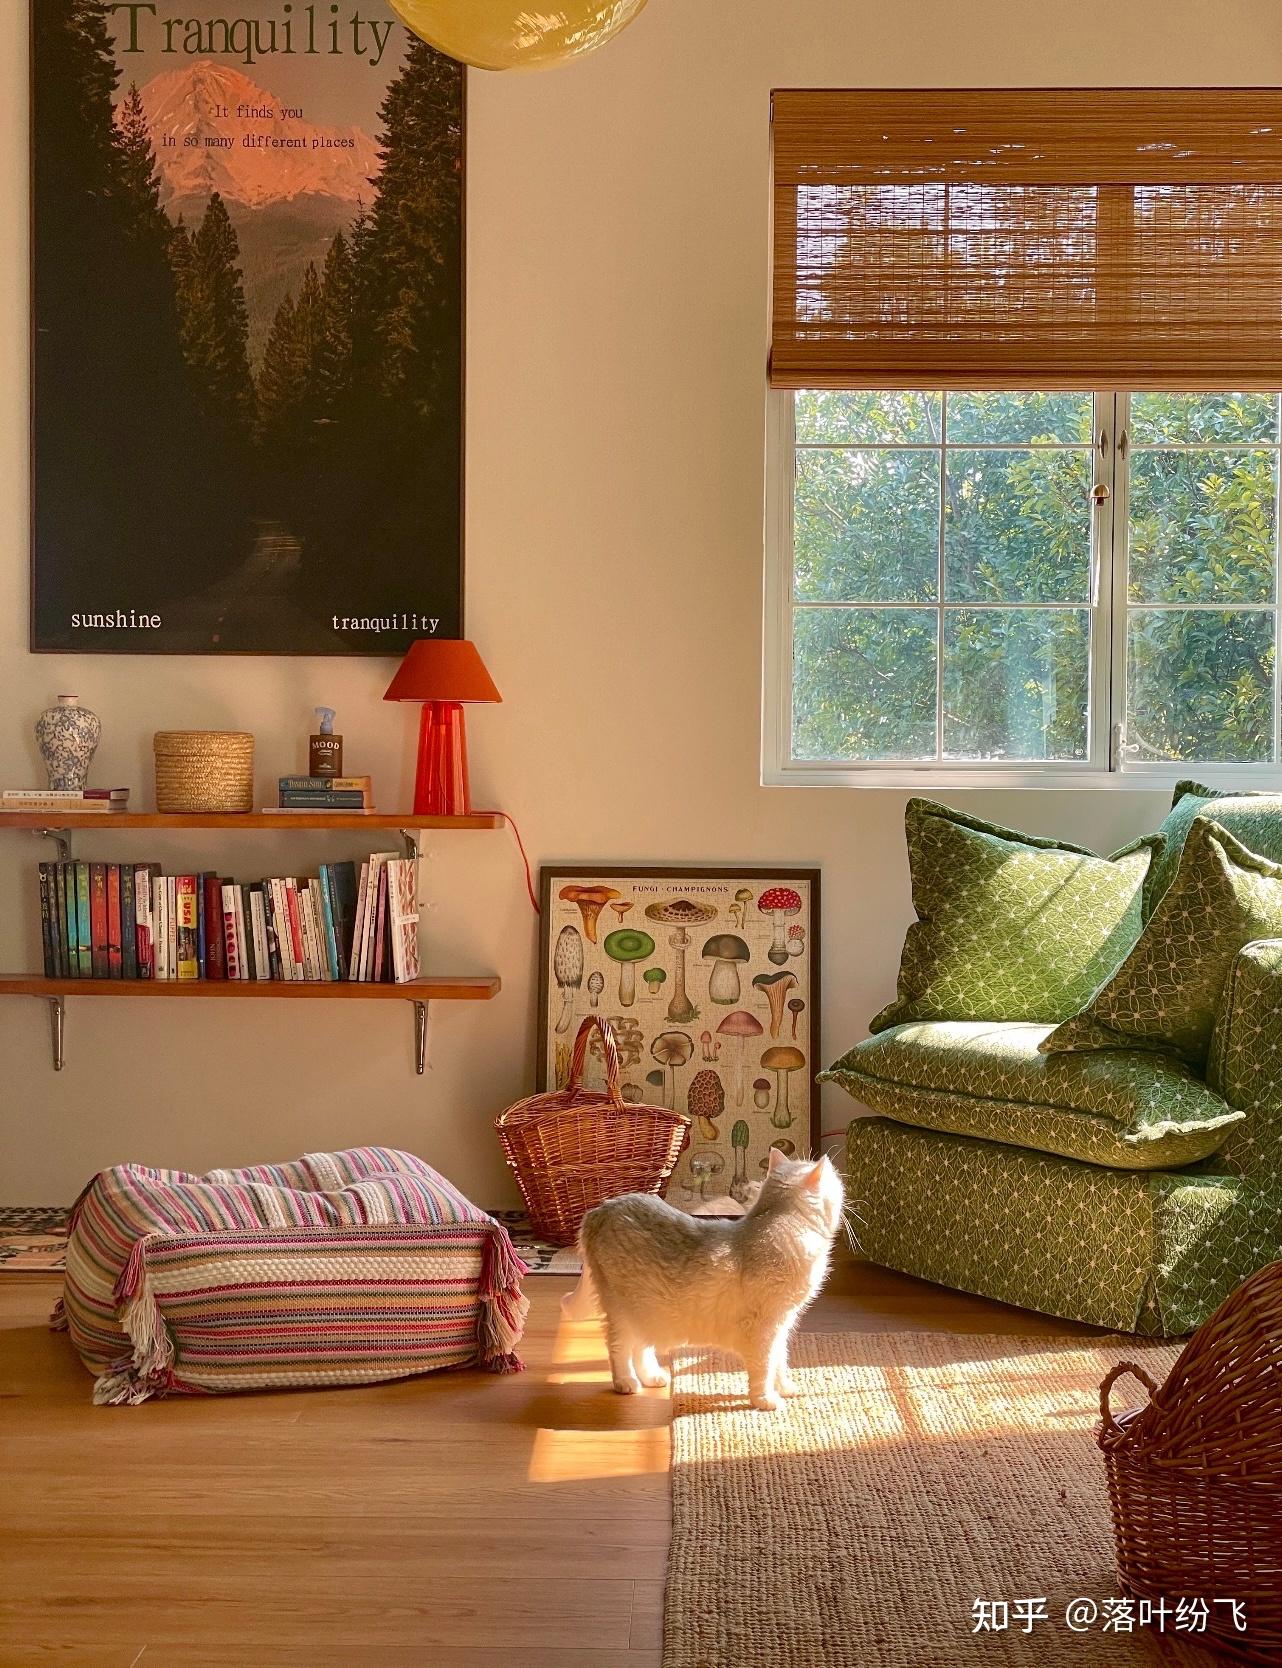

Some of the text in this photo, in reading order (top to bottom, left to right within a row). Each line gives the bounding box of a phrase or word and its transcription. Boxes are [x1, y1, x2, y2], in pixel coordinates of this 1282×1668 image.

[111, 3, 396, 67] Tranquility
[214, 104, 303, 123] It finds you
[162, 133, 355, 151] in so many different places
[71, 609, 162, 629] sunshine
[332, 614, 440, 634] tranquility
[312, 741, 340, 750] MOOD
[183, 902, 192, 925] USA
